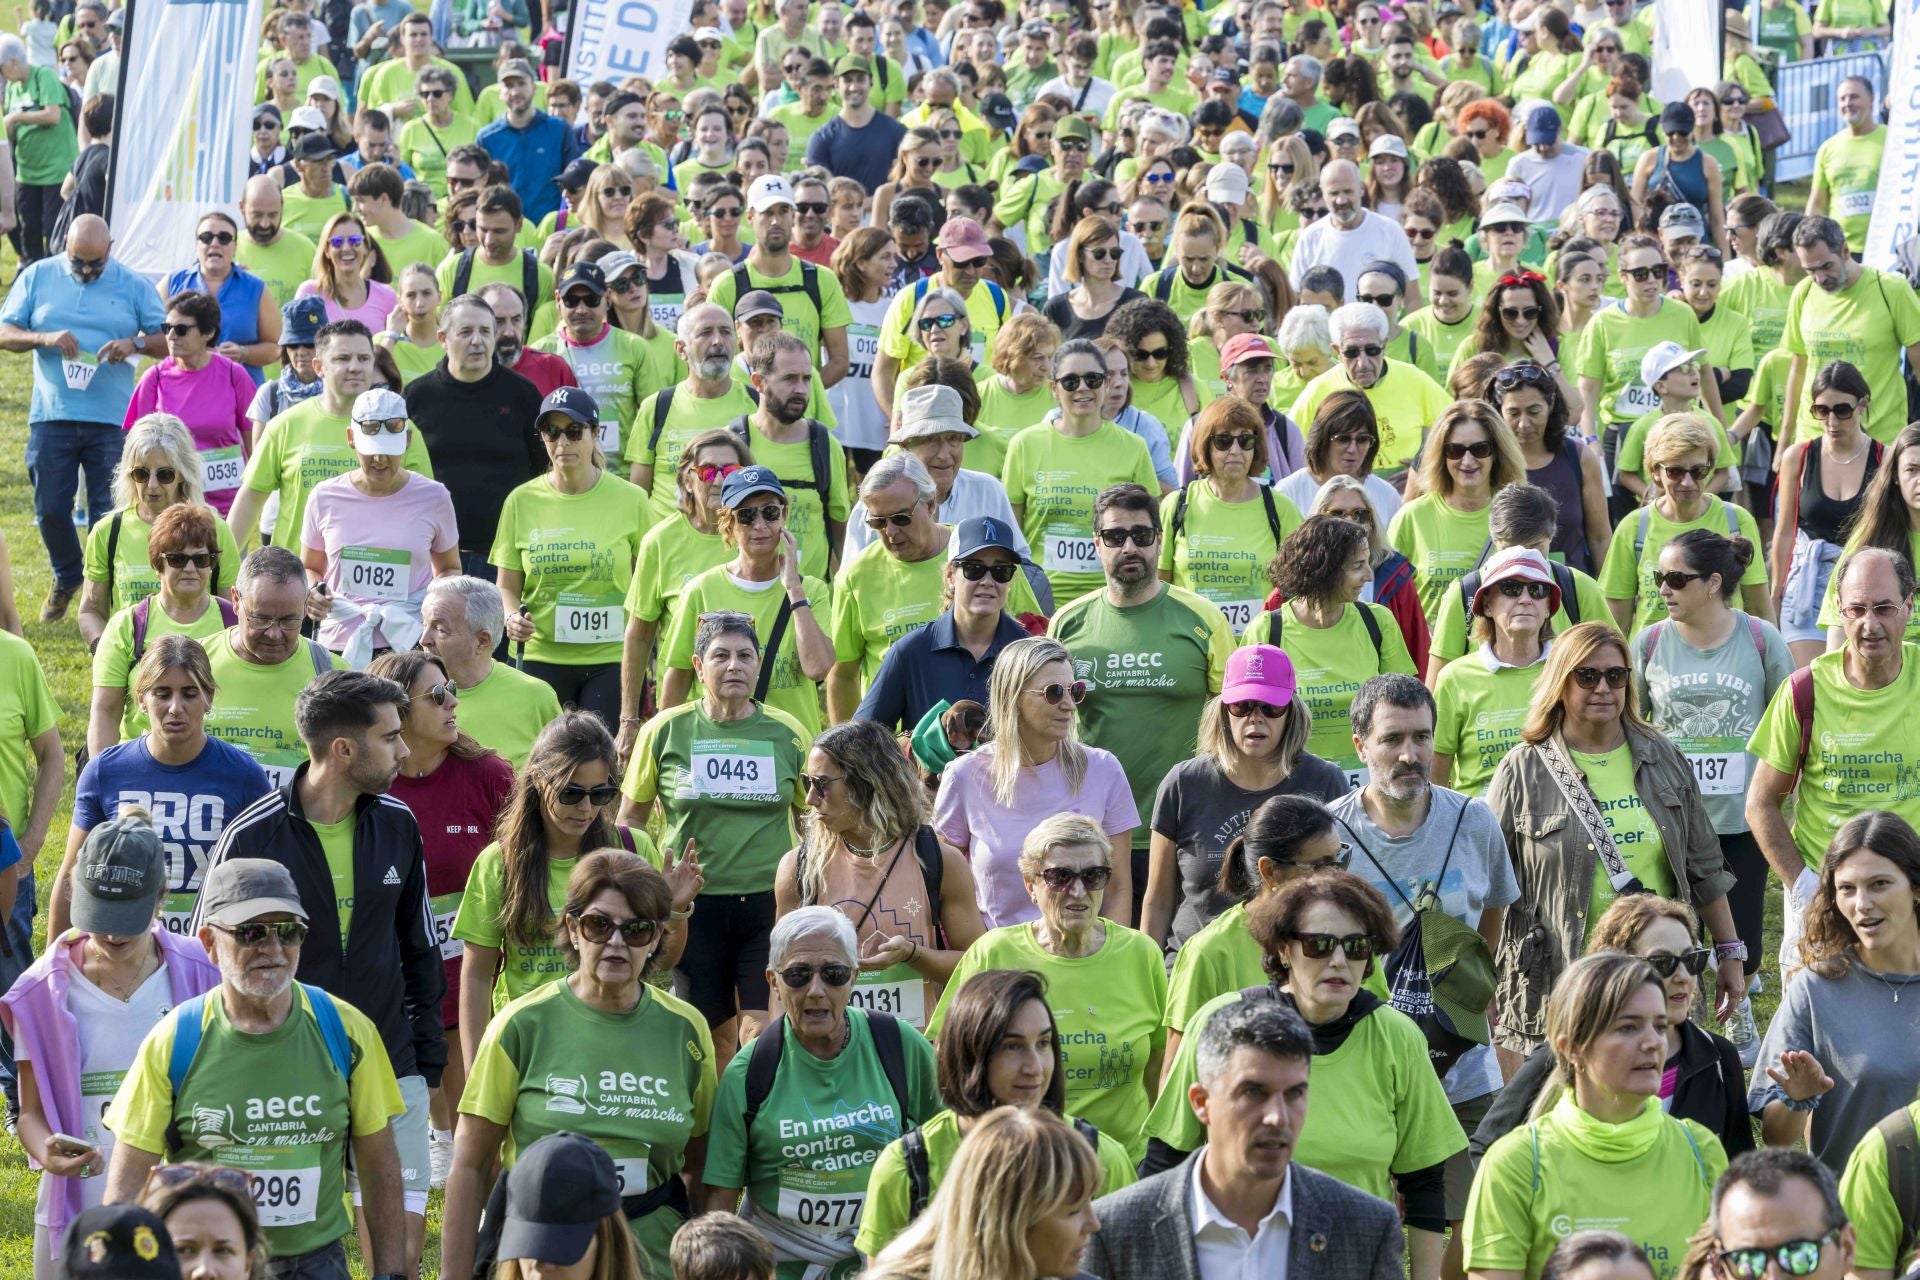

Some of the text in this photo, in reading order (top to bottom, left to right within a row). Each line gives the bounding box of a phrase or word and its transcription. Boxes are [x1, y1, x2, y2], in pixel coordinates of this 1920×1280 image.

[650, 306, 677, 320] 554
[577, 361, 623, 376] aecc
[301, 457, 316, 466] En
[207, 462, 238, 482] 0536
[301, 467, 339, 479] contra
[1035, 484, 1098, 495] En marcha
[1035, 496, 1072, 506] contra
[529, 540, 596, 553] En marcha
[1057, 540, 1096, 561] 0102
[529, 552, 569, 564] contra
[1188, 549, 1257, 560] En marcha
[543, 562, 587, 575] cáncer
[1187, 561, 1229, 571] contra
[1428, 566, 1442, 576] En
[353, 564, 395, 588] 0182
[1202, 571, 1247, 584] cáncer
[130, 578, 161, 589] marc
[570, 611, 609, 631] 0191
[886, 621, 902, 636] En
[1106, 652, 1162, 669] aecc
[1106, 669, 1150, 678] CANTABRIA
[1104, 673, 1177, 689] en marcha
[1306, 681, 1360, 695] marcha
[225, 725, 283, 740] marcha
[1477, 729, 1494, 742] En
[1482, 755, 1495, 769] el
[1822, 750, 1903, 765] En marcha
[707, 758, 759, 781] 0443
[1823, 767, 1870, 779] contra
[1823, 780, 1892, 794] el cáncer
[447, 825, 462, 834] KEEP
[111, 865, 145, 888] YORK
[520, 959, 535, 973] el
[850, 987, 901, 1013] 0131
[1059, 1030, 1106, 1045] archa
[599, 1070, 670, 1097] aecc
[246, 1095, 322, 1119] aecc
[599, 1094, 657, 1106] CANTABRIA
[597, 1105, 685, 1123] en marcha
[779, 1103, 894, 1139] En marcha
[248, 1120, 307, 1133] CANTABRIA
[245, 1127, 336, 1146] en marcha
[782, 1134, 856, 1158] contra
[782, 1169, 817, 1178] Santander
[798, 1198, 863, 1227] 0277
